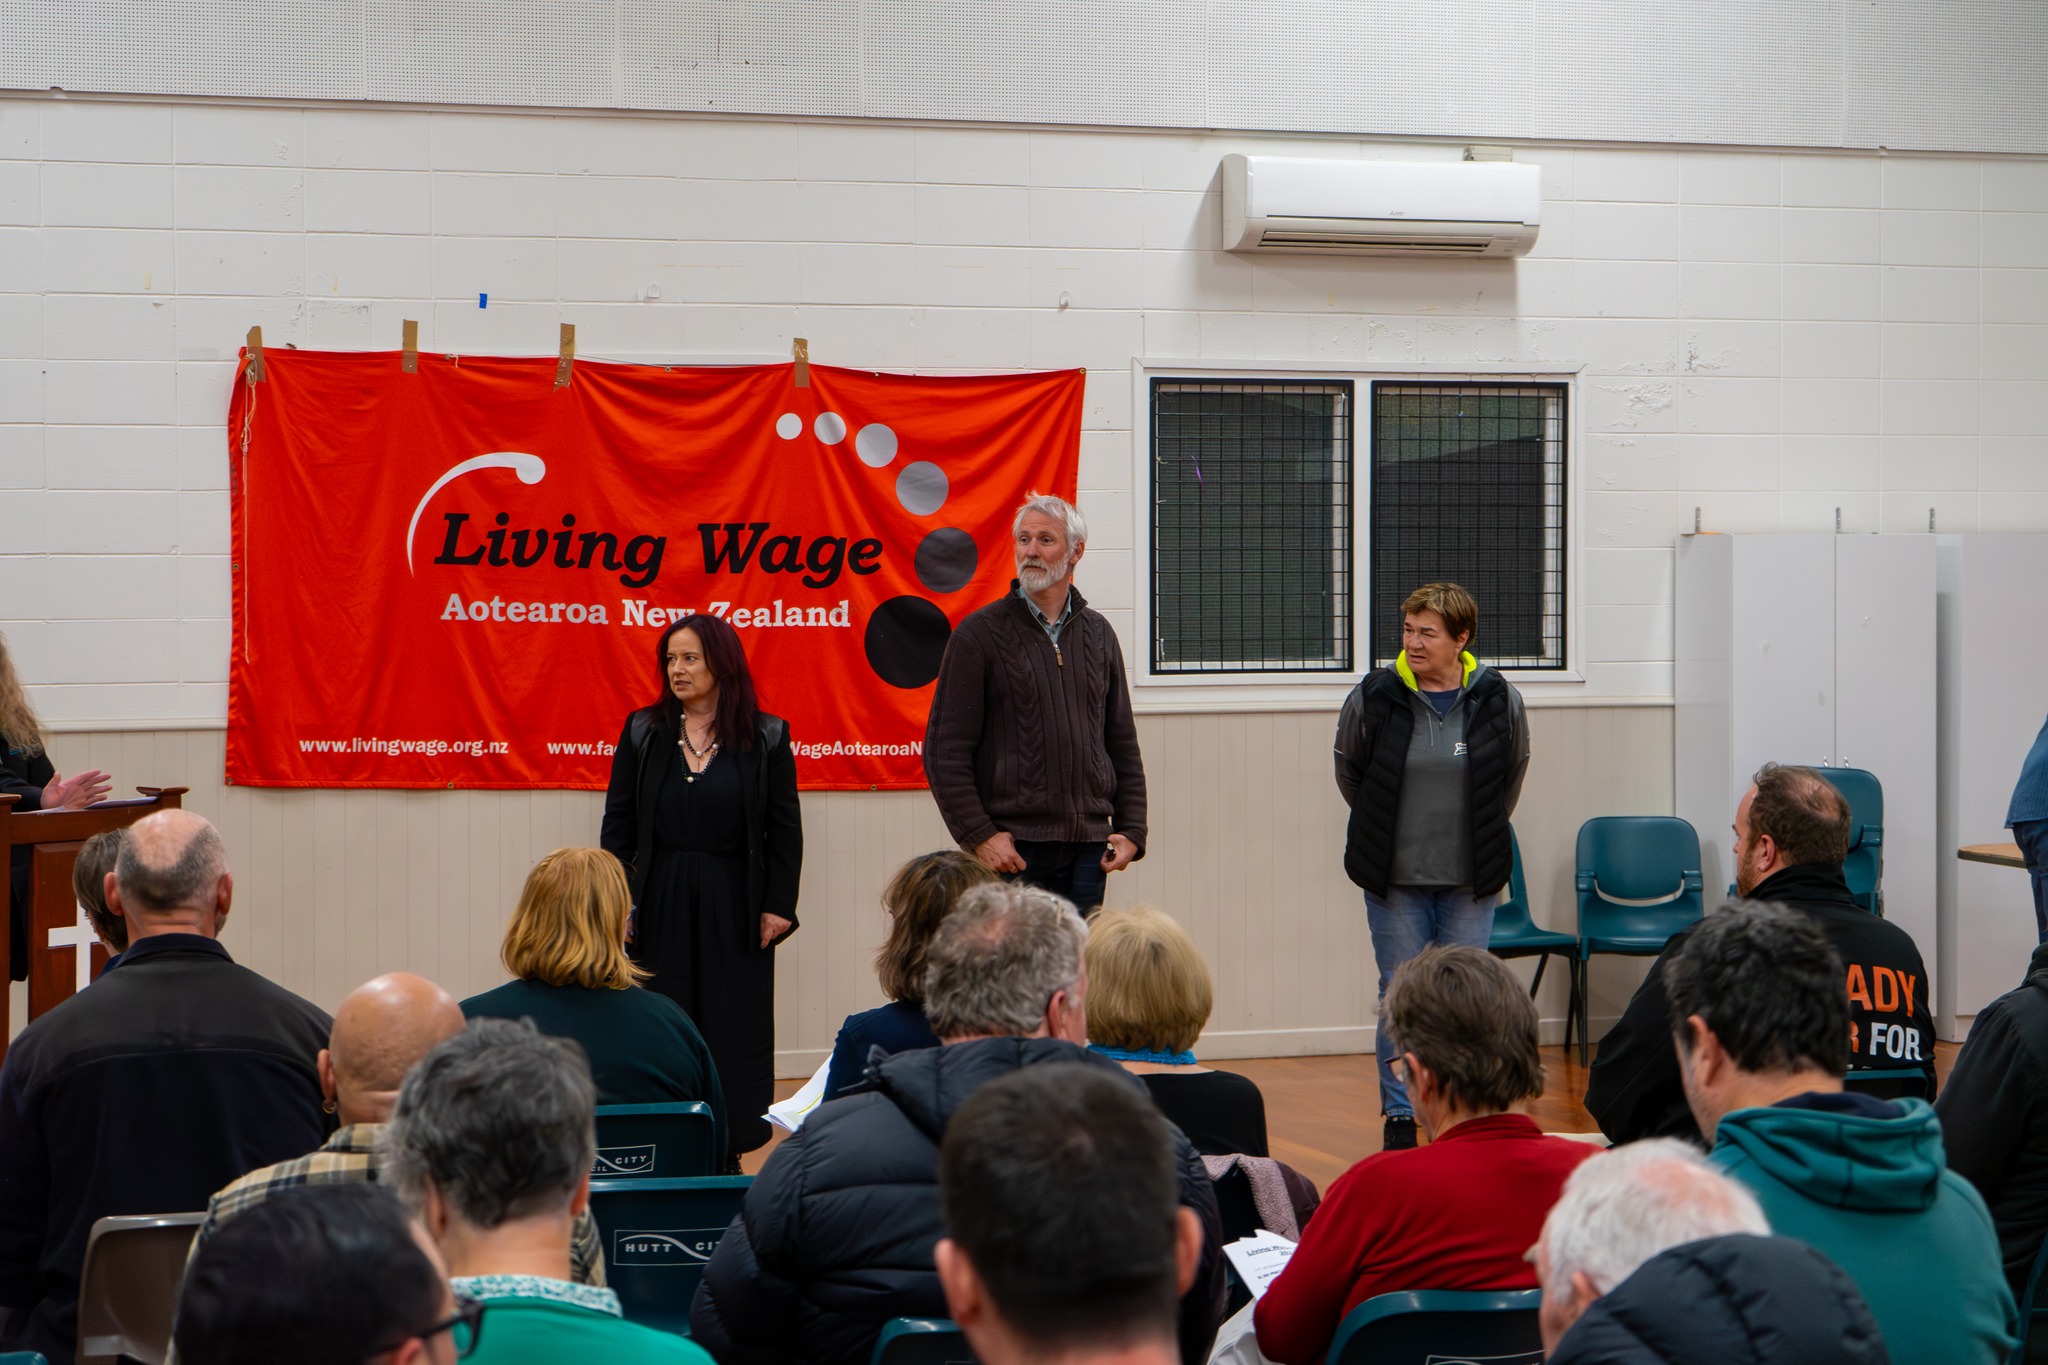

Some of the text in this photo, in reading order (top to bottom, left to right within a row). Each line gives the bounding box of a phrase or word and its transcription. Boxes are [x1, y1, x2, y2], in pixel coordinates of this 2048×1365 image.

[433, 512, 883, 589] Living Wage
[440, 593, 609, 625] Aotearoa
[707, 600, 851, 628] Zealand
[300, 737, 509, 757] www.livingwage.org.nz
[547, 740, 618, 756] www.fa
[1869, 1021, 1923, 1061] FOR
[614, 1155, 647, 1165] CITY
[625, 1243, 673, 1253] HUTT
